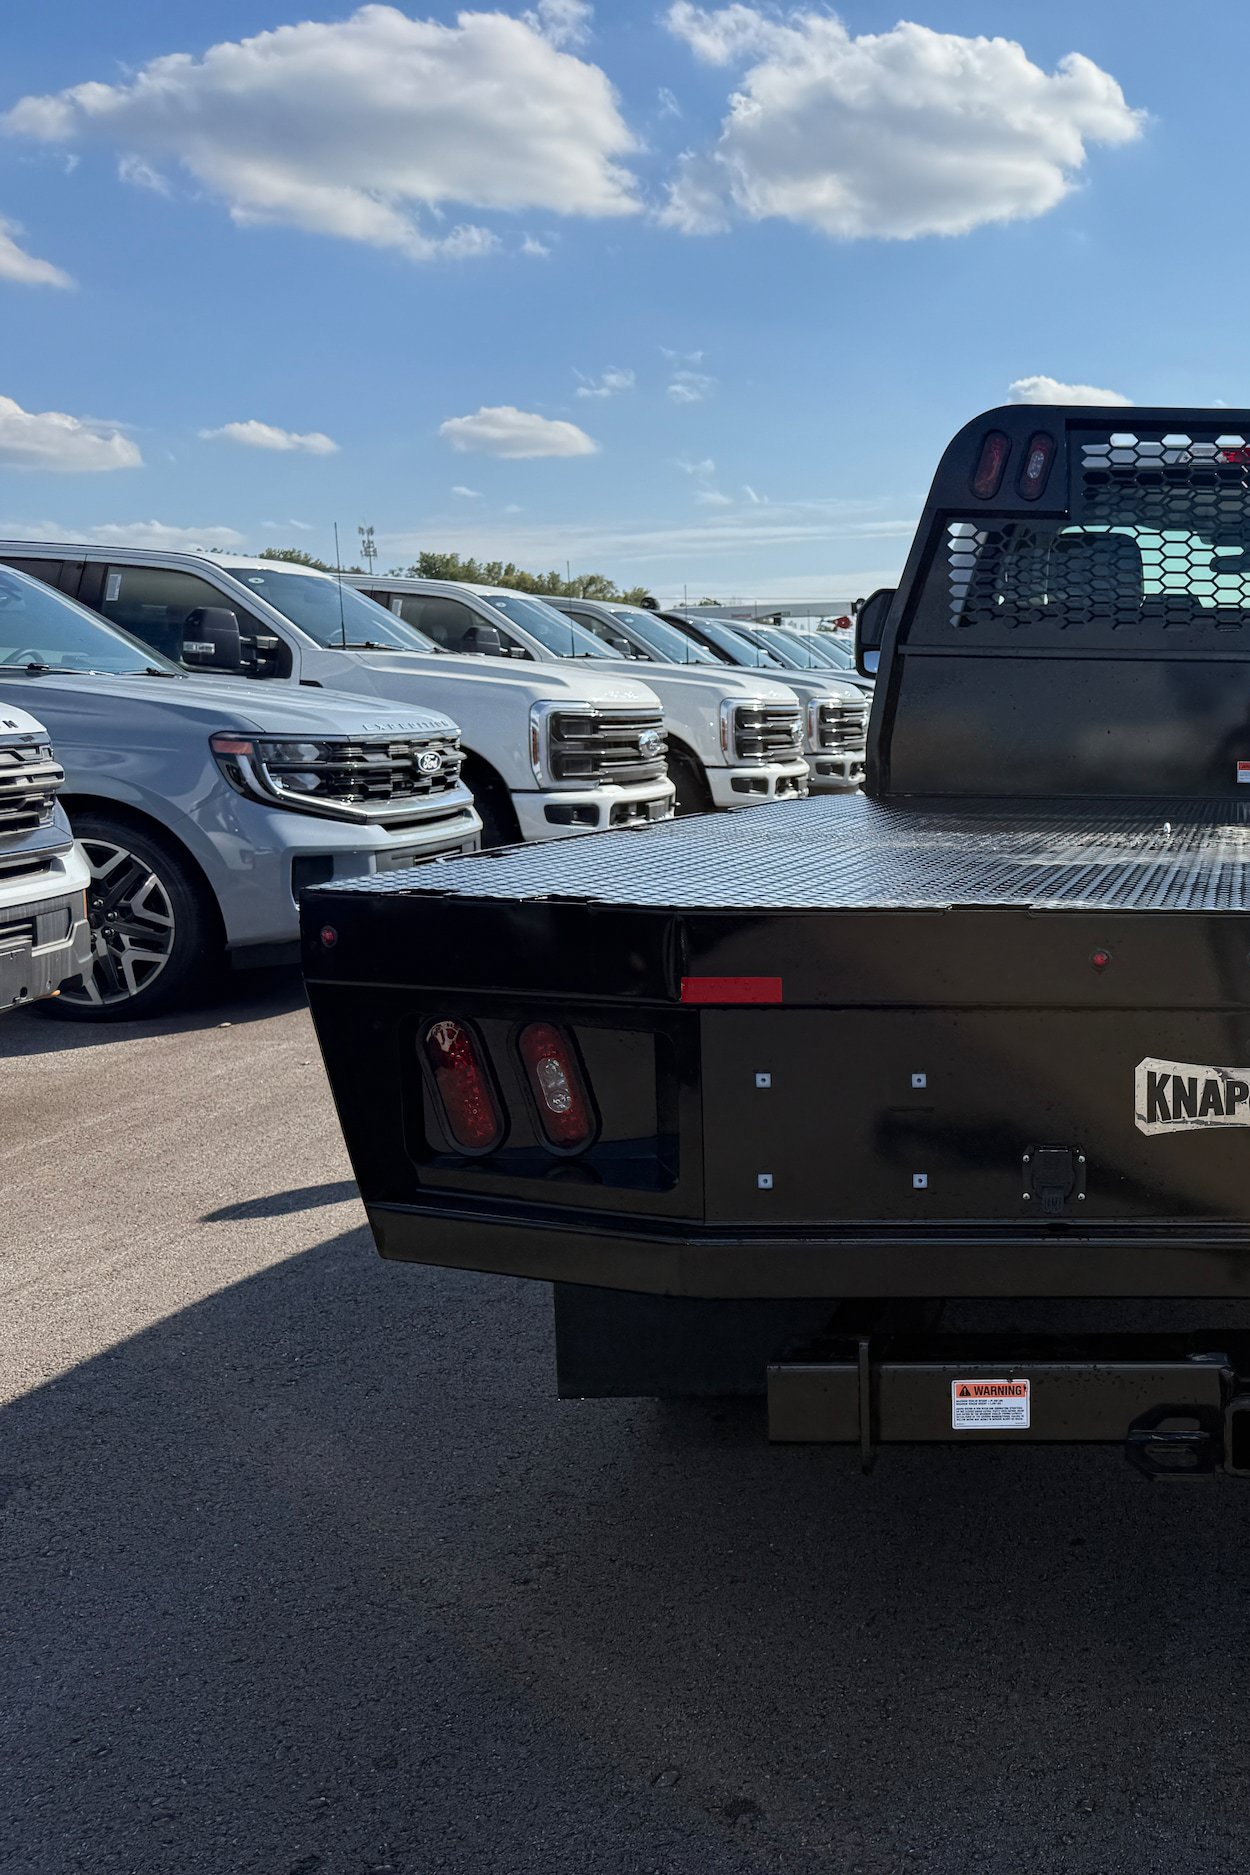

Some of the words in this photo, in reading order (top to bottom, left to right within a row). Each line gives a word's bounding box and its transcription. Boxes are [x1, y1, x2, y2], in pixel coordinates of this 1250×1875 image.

[362, 719, 449, 731] EXPEDITION
[422, 754, 439, 770] Ford
[974, 1385, 1022, 1396] WARNING
